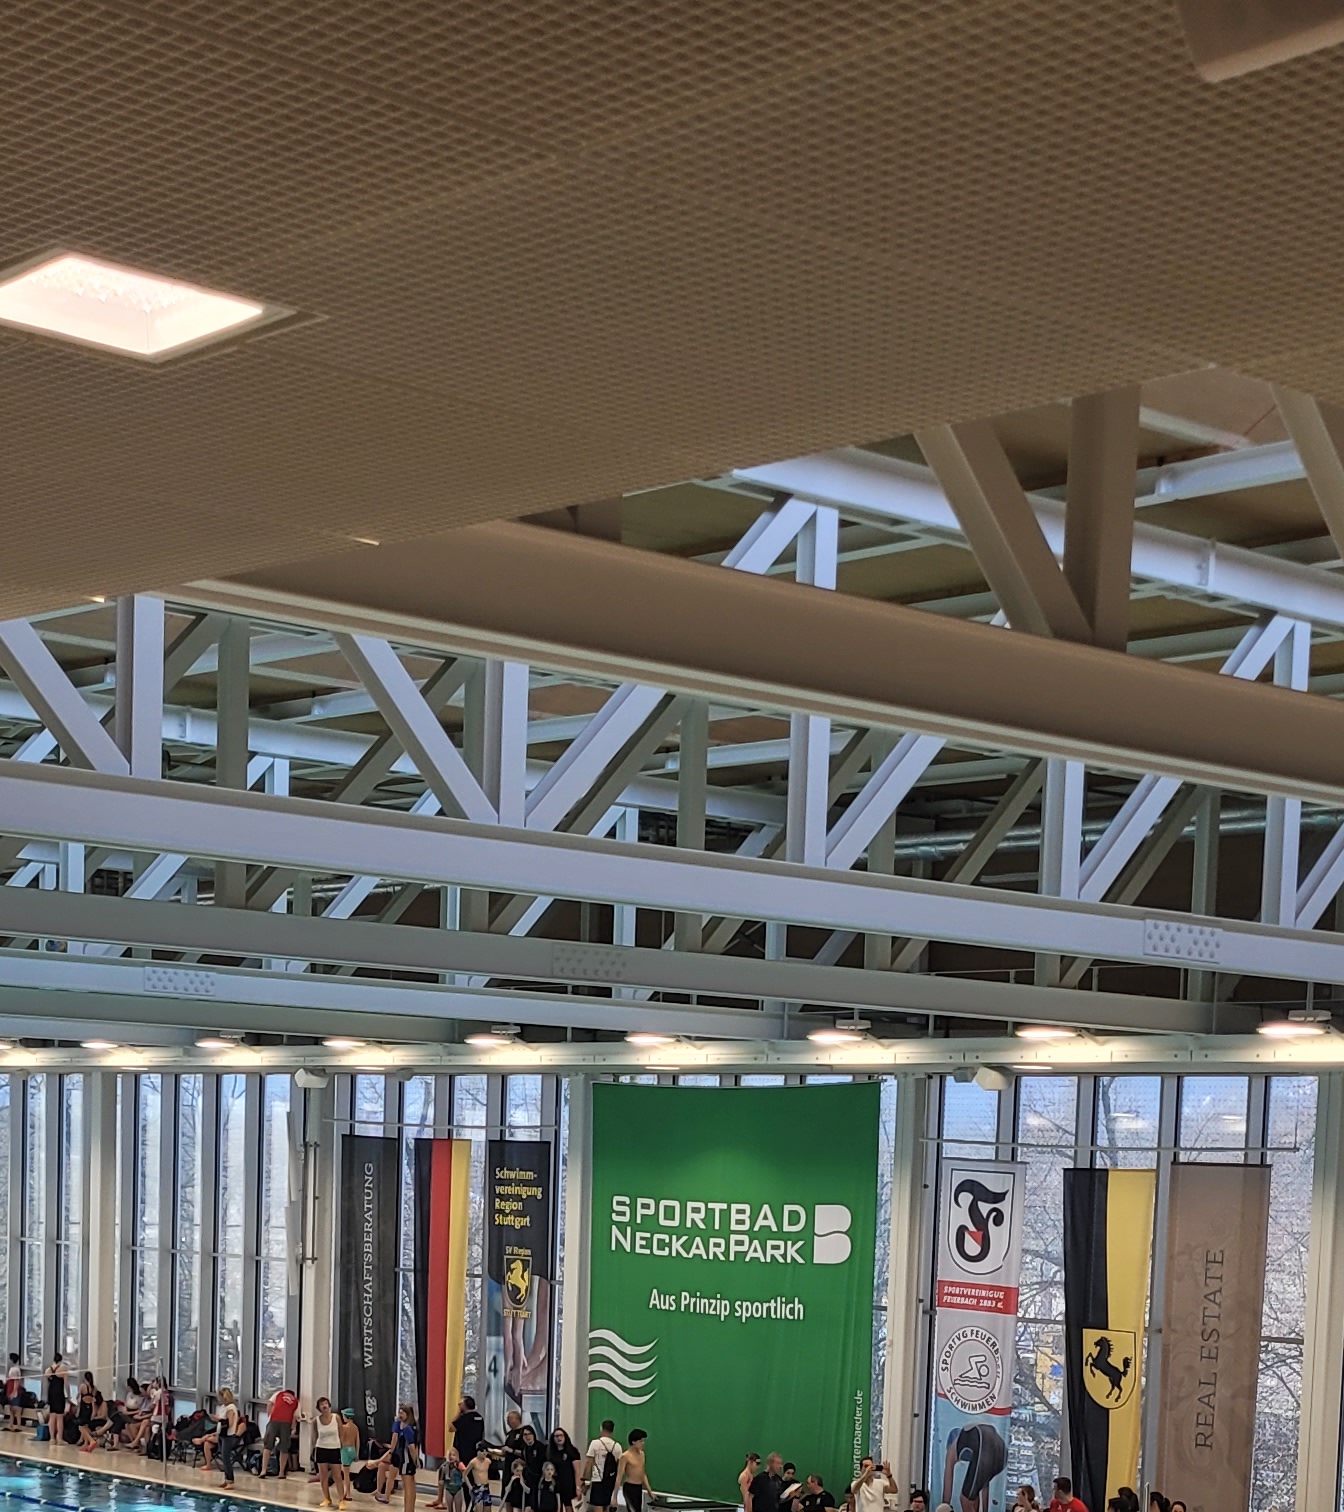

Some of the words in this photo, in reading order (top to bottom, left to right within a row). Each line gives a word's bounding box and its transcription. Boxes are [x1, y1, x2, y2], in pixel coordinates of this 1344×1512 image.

[495, 1168, 537, 1180] Schwimm-
[495, 1183, 543, 1199] vereinigung
[495, 1199, 522, 1212] Region
[612, 1195, 806, 1233] SPORTBAD
[495, 1214, 530, 1228] Stuttgart
[506, 1246, 512, 1254] SV
[363, 1162, 374, 1368] WIRTSCHAFTSBERATUNG
[649, 1289, 676, 1311] Aus
[680, 1292, 730, 1321] Prinzip
[734, 1297, 804, 1322] sportlich
[943, 1296, 977, 1305] FEUERBACH
[1200, 1250, 1224, 1363] ESTATE
[941, 1330, 968, 1372] SPORTVG
[488, 1354, 498, 1378] 4
[946, 1387, 996, 1411] SCHWIMMEN
[1194, 1372, 1217, 1450] REAL
